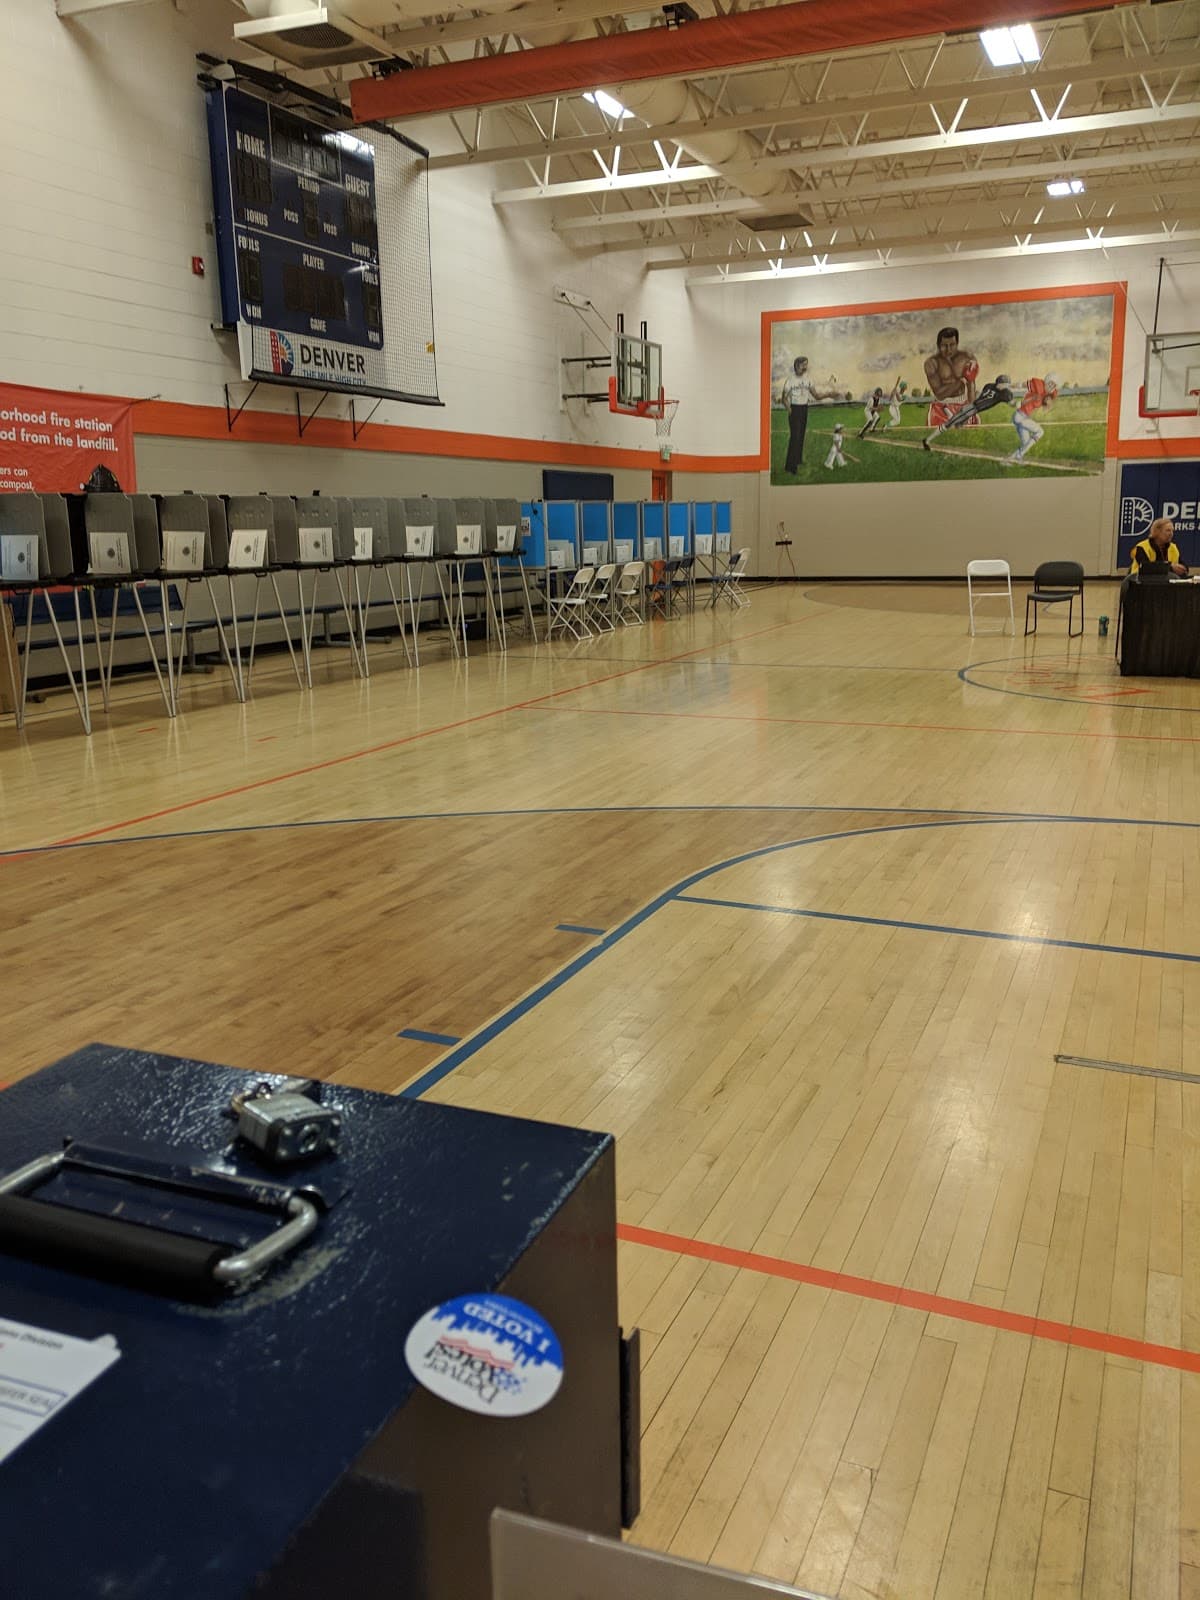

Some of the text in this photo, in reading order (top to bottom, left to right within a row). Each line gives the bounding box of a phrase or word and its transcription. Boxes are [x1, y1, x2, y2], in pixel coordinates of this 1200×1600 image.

[236, 131, 265, 159] HOME
[297, 176, 320, 195] PERIOD
[345, 174, 371, 197] GUEST
[245, 208, 268, 226] BONUS
[283, 208, 299, 224] POSS
[238, 235, 260, 253] FOULS
[302, 253, 325, 271] PLAYER
[245, 304, 262, 320] WON
[300, 344, 366, 374] DENVER
[50, 413, 71, 428] fire
[74, 417, 113, 433] station
[20, 428, 51, 445] from
[54, 432, 73, 447] the
[77, 435, 119, 452] landfill.
[13, 468, 28, 477] can
[463, 1301, 535, 1345] VOTED
[539, 1338, 553, 1354] I
[424, 1356, 500, 1405] Denver
